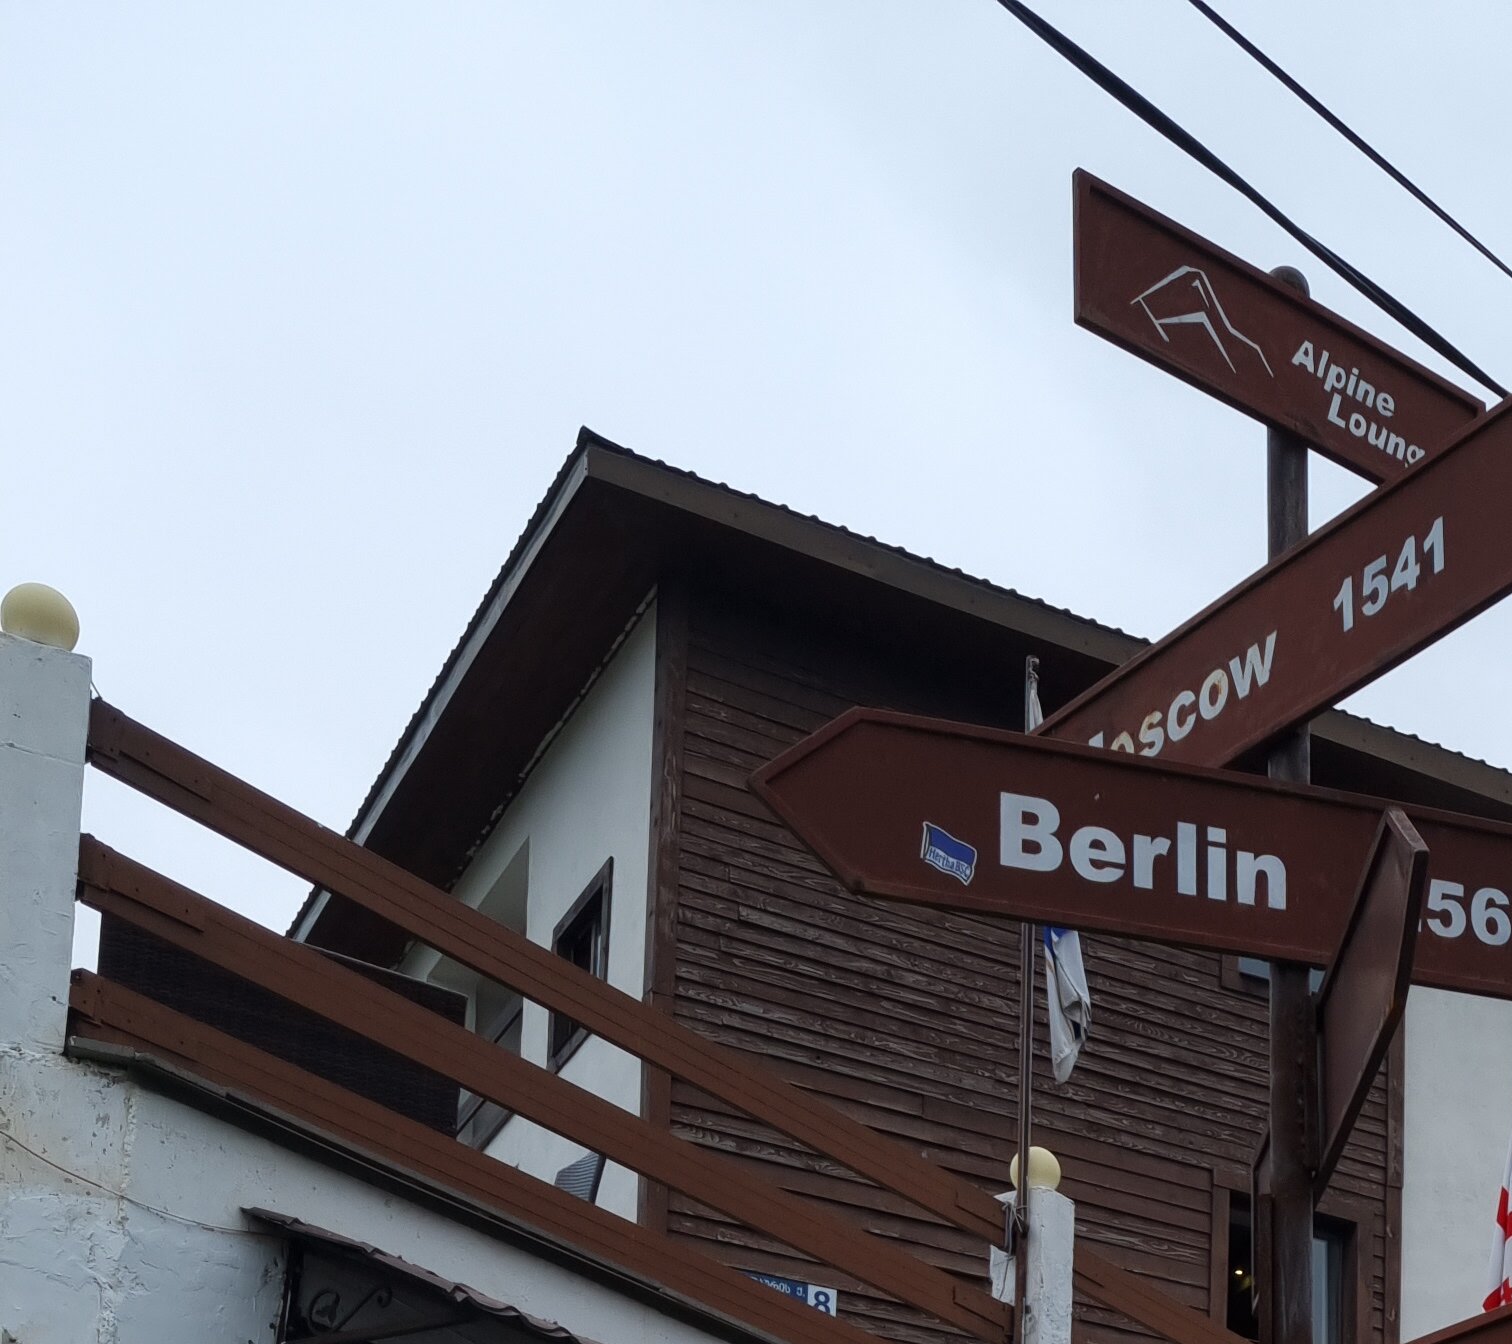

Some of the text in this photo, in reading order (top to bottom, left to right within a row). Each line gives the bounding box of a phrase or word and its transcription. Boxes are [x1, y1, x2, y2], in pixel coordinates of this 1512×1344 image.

[1291, 340, 1395, 417] Alpine
[1327, 392, 1426, 468] Loung
[1088, 516, 1445, 757] scow 1541
[999, 791, 1287, 910] Berlin
[813, 1290, 831, 1314] 8
